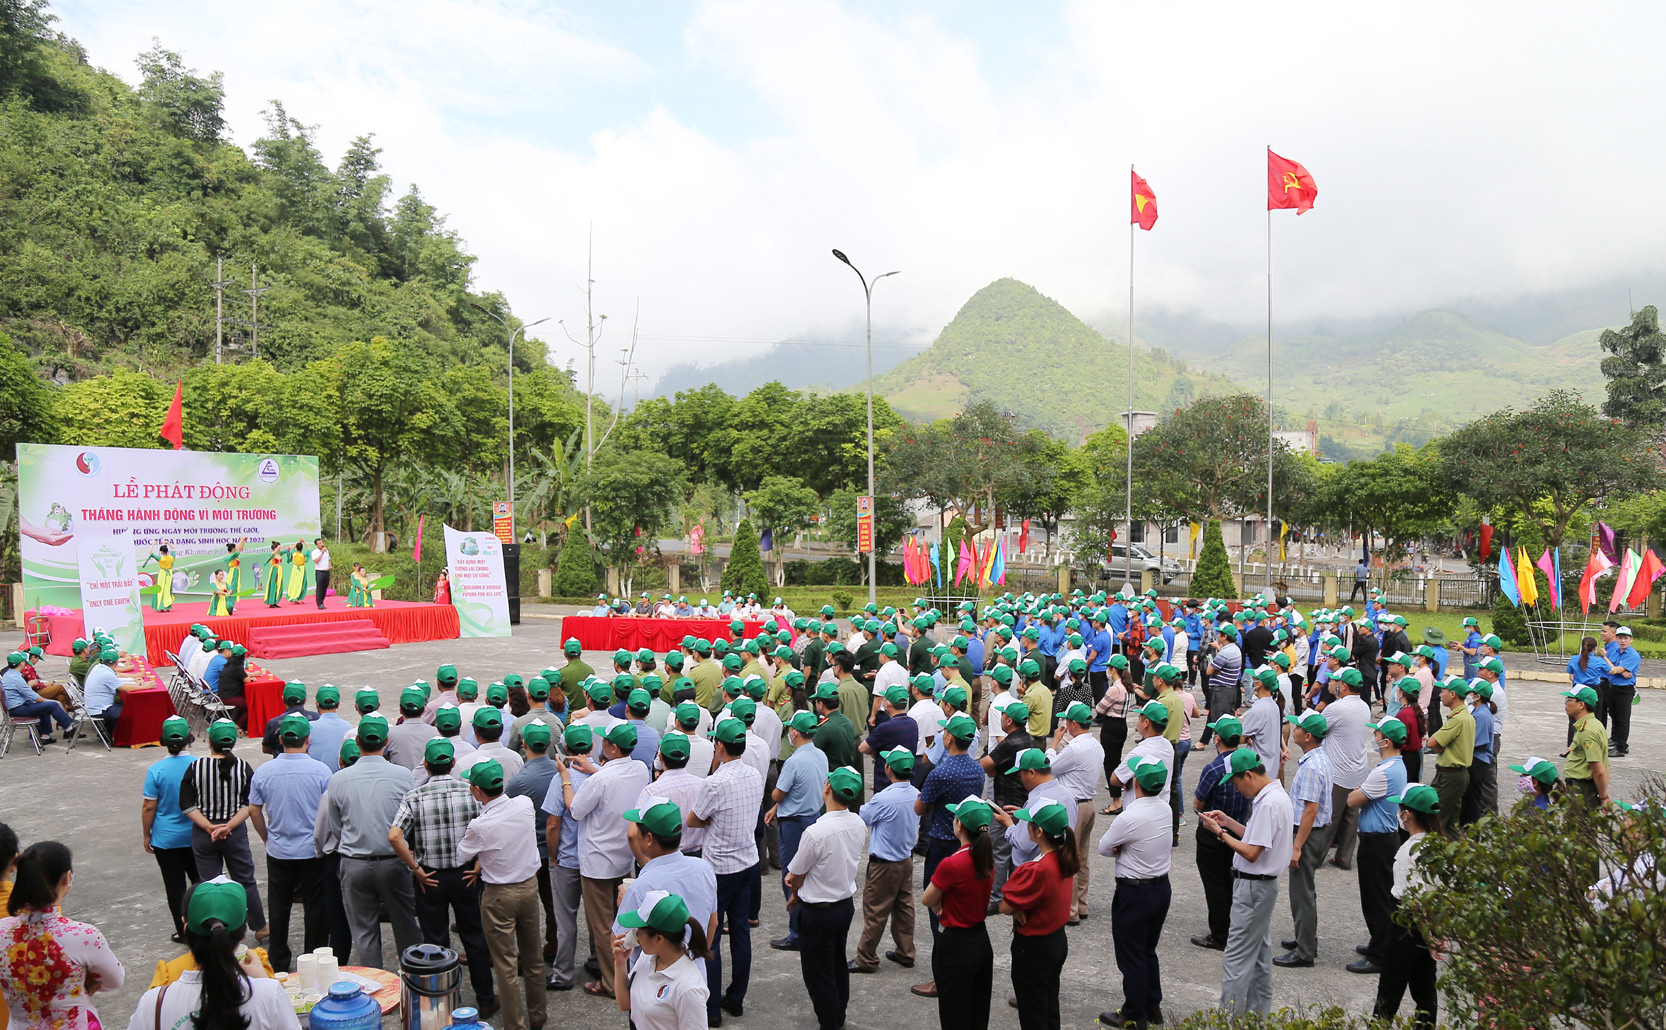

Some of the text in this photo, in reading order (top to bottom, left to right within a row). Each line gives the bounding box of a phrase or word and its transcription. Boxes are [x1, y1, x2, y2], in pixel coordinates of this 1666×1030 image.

[113, 477, 250, 502] LỄ PHÁT ĐỘNG
[81, 507, 276, 523] THÁNG HÀNH ĐỘNG VÌ MÔI TRƯỜNG
[161, 526, 182, 535] NGÀY
[183, 526, 198, 534] MÔI
[200, 526, 228, 534] TRƯỜNG
[230, 526, 242, 534] THẾ
[176, 537, 196, 547] DẠNG
[216, 538, 231, 546] HỌC
